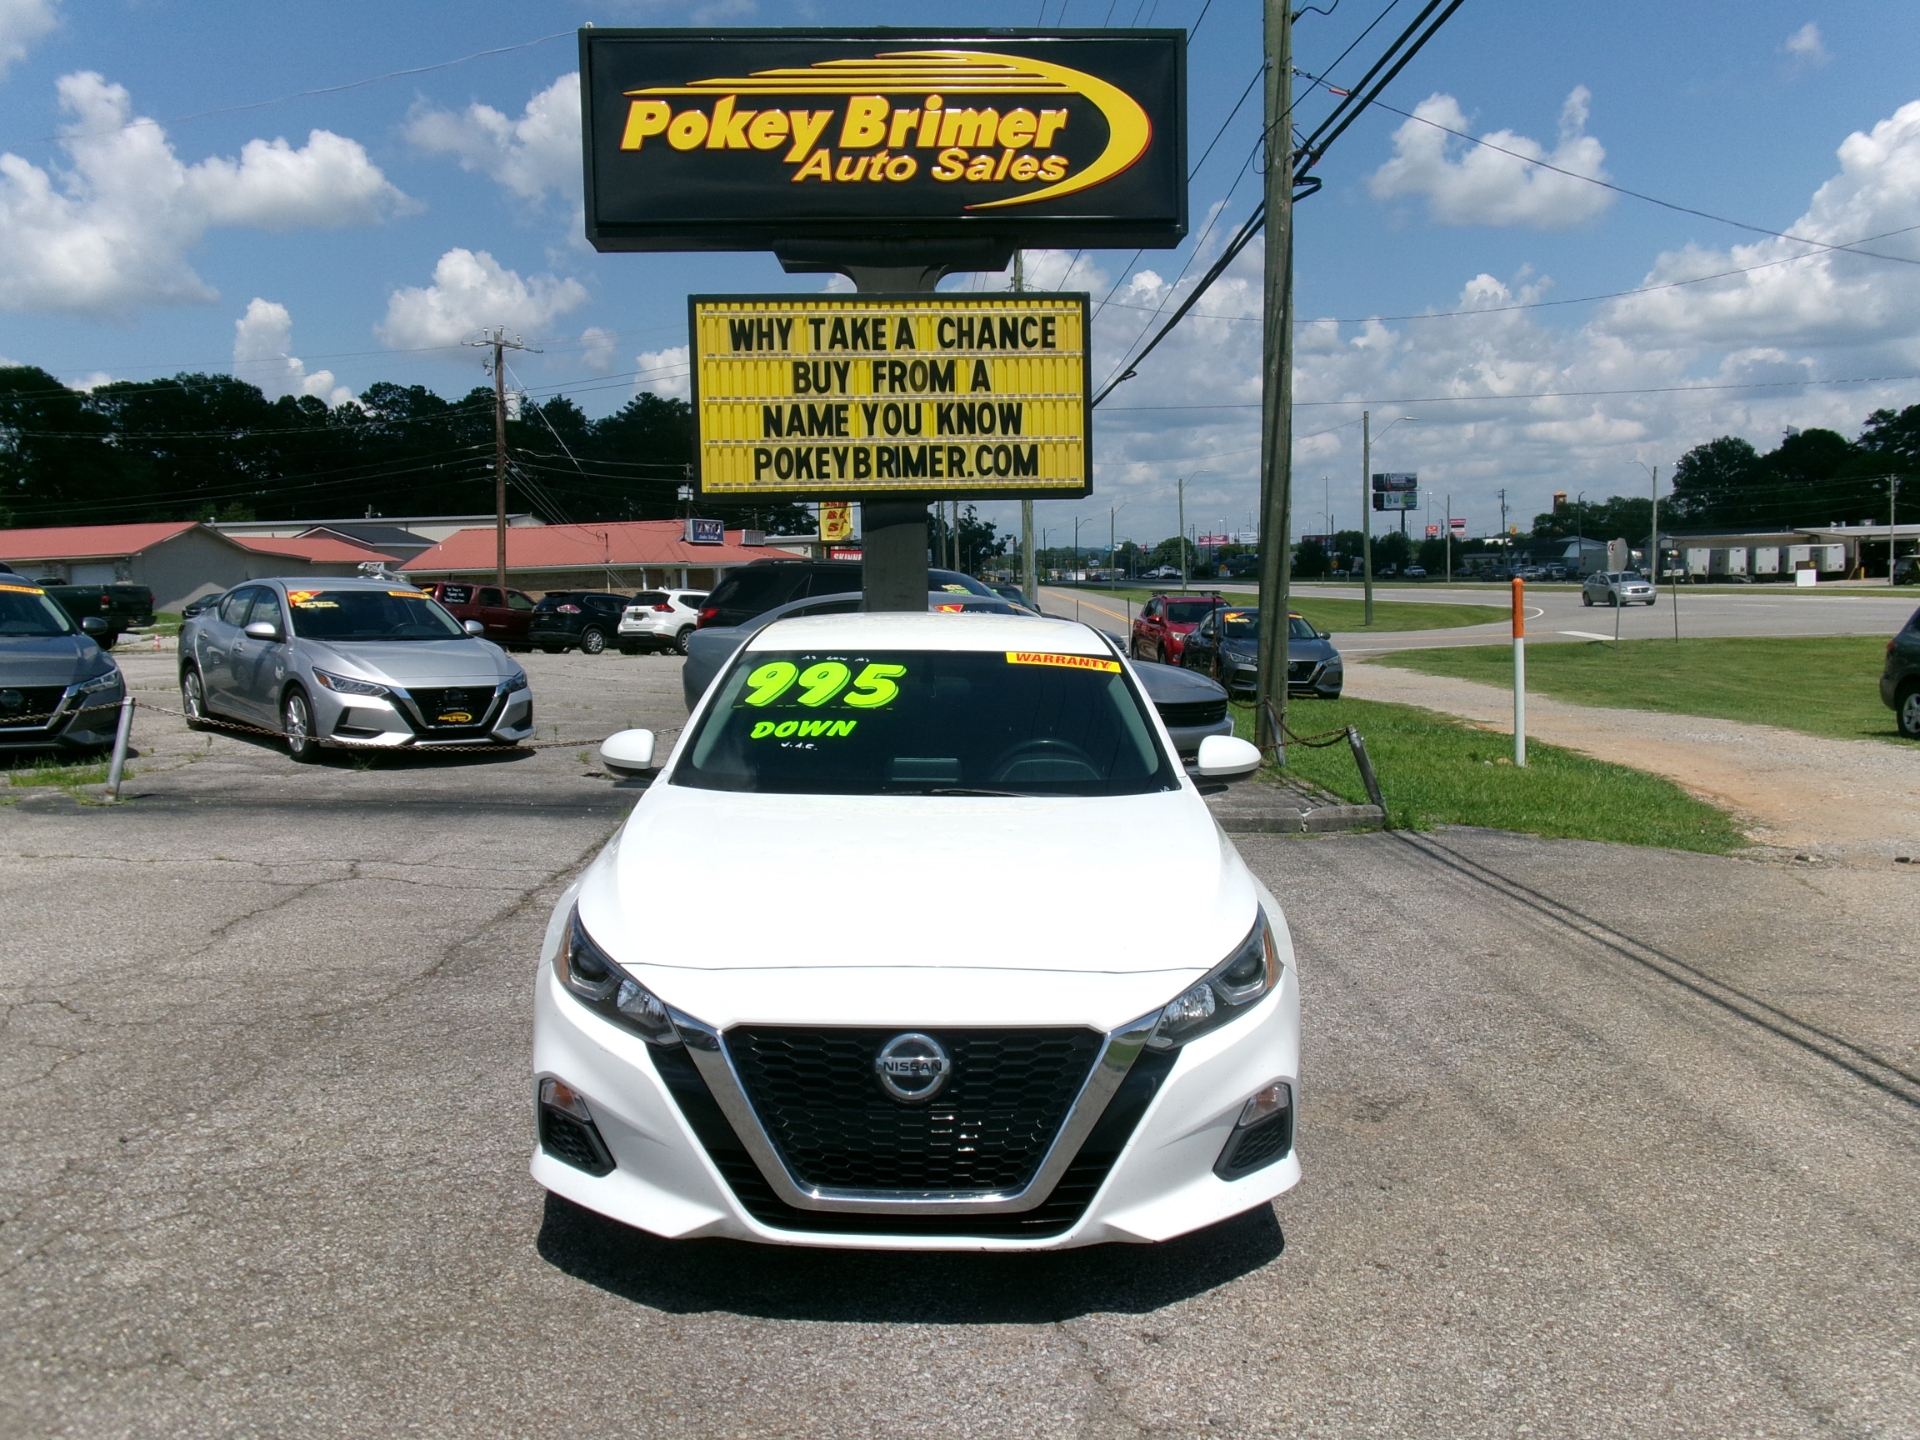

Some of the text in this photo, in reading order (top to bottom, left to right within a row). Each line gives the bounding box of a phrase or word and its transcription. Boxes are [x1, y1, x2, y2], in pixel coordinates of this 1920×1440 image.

[621, 94, 1069, 163] Pokey Brimer
[791, 147, 1069, 182] Auto Sales
[729, 316, 1056, 351] WHY TAKE A CHANCE
[793, 359, 991, 394] BUY FROM A
[763, 402, 1023, 437] NAME YOU KNOW
[754, 444, 1038, 480] POKEYBRIMER.COM
[1016, 652, 1111, 669] WARRANTY
[745, 661, 907, 708] 995
[750, 720, 857, 739] DOWN
[883, 1061, 942, 1072] NISSAN
